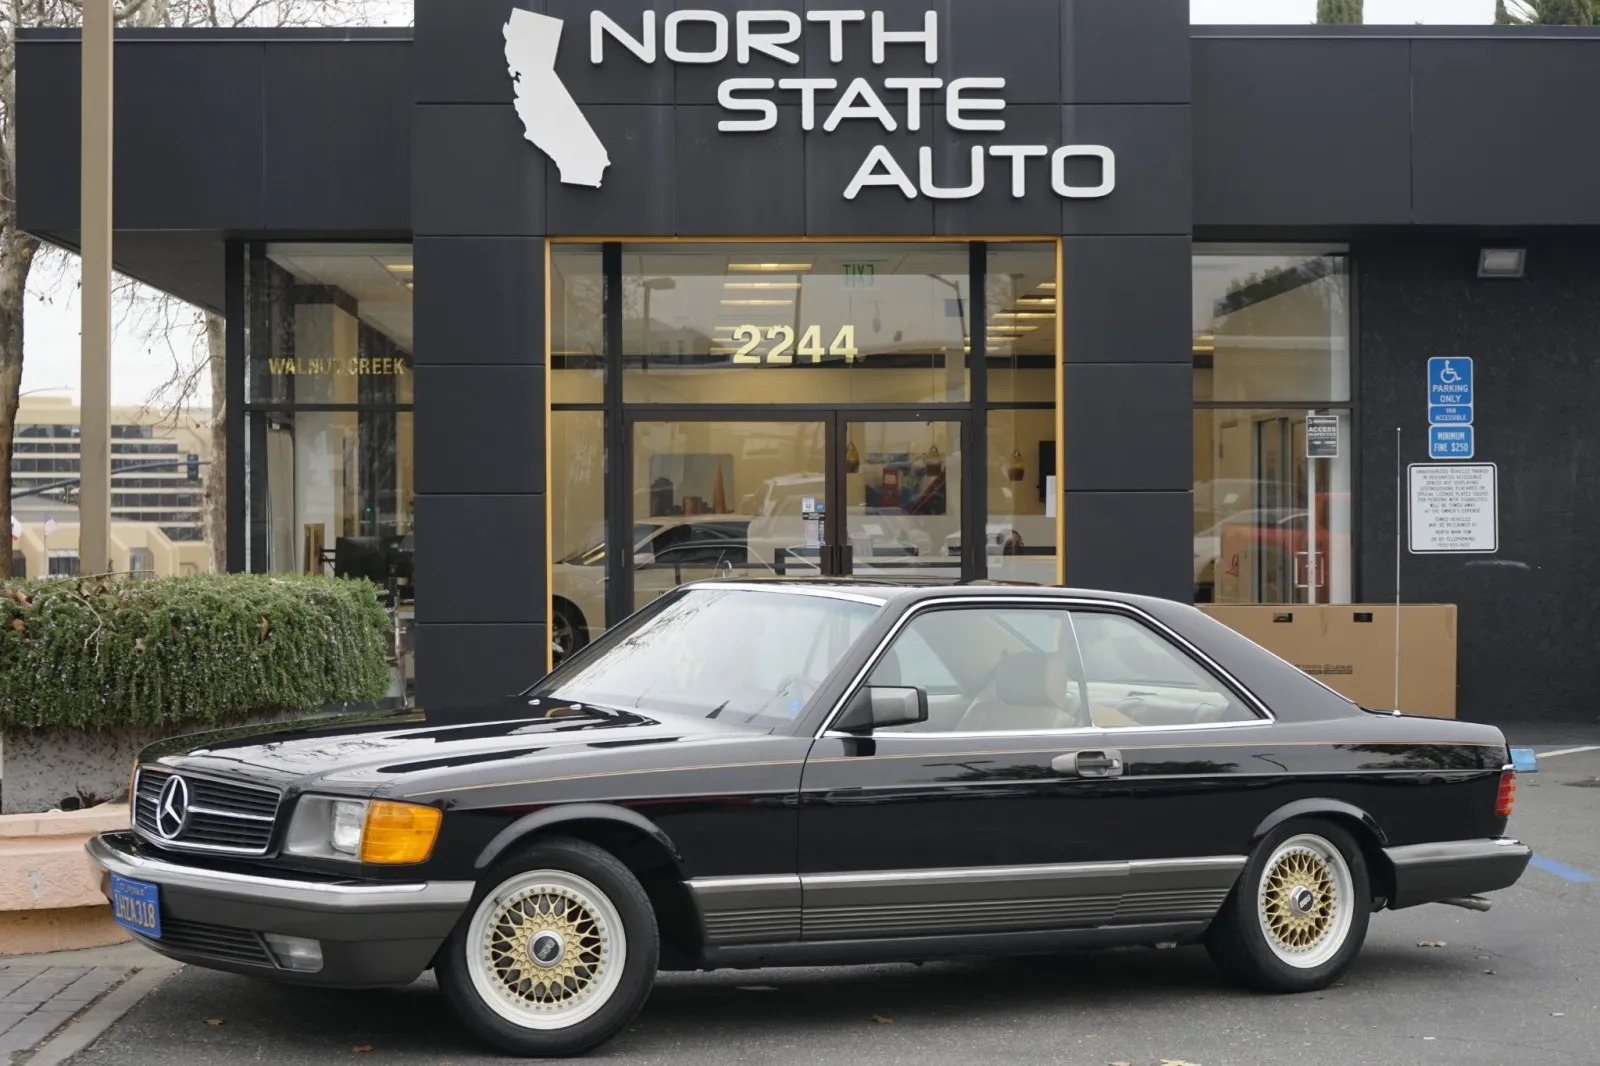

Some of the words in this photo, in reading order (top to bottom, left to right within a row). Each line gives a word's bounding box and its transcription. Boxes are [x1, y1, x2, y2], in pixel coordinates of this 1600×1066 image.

[590, 10, 938, 64] NORTH
[717, 77, 1006, 132] STATE
[842, 144, 1115, 199] AUTO
[732, 324, 859, 364] 2244
[268, 357, 342, 375] WALNUT
[349, 357, 405, 375] CREEK
[1432, 384, 1469, 393] PARKING
[1439, 395, 1462, 403] ONLY
[1437, 431, 1465, 440] MINIMUM
[1434, 443, 1448, 452] FINE
[1451, 442, 1469, 453] $250
